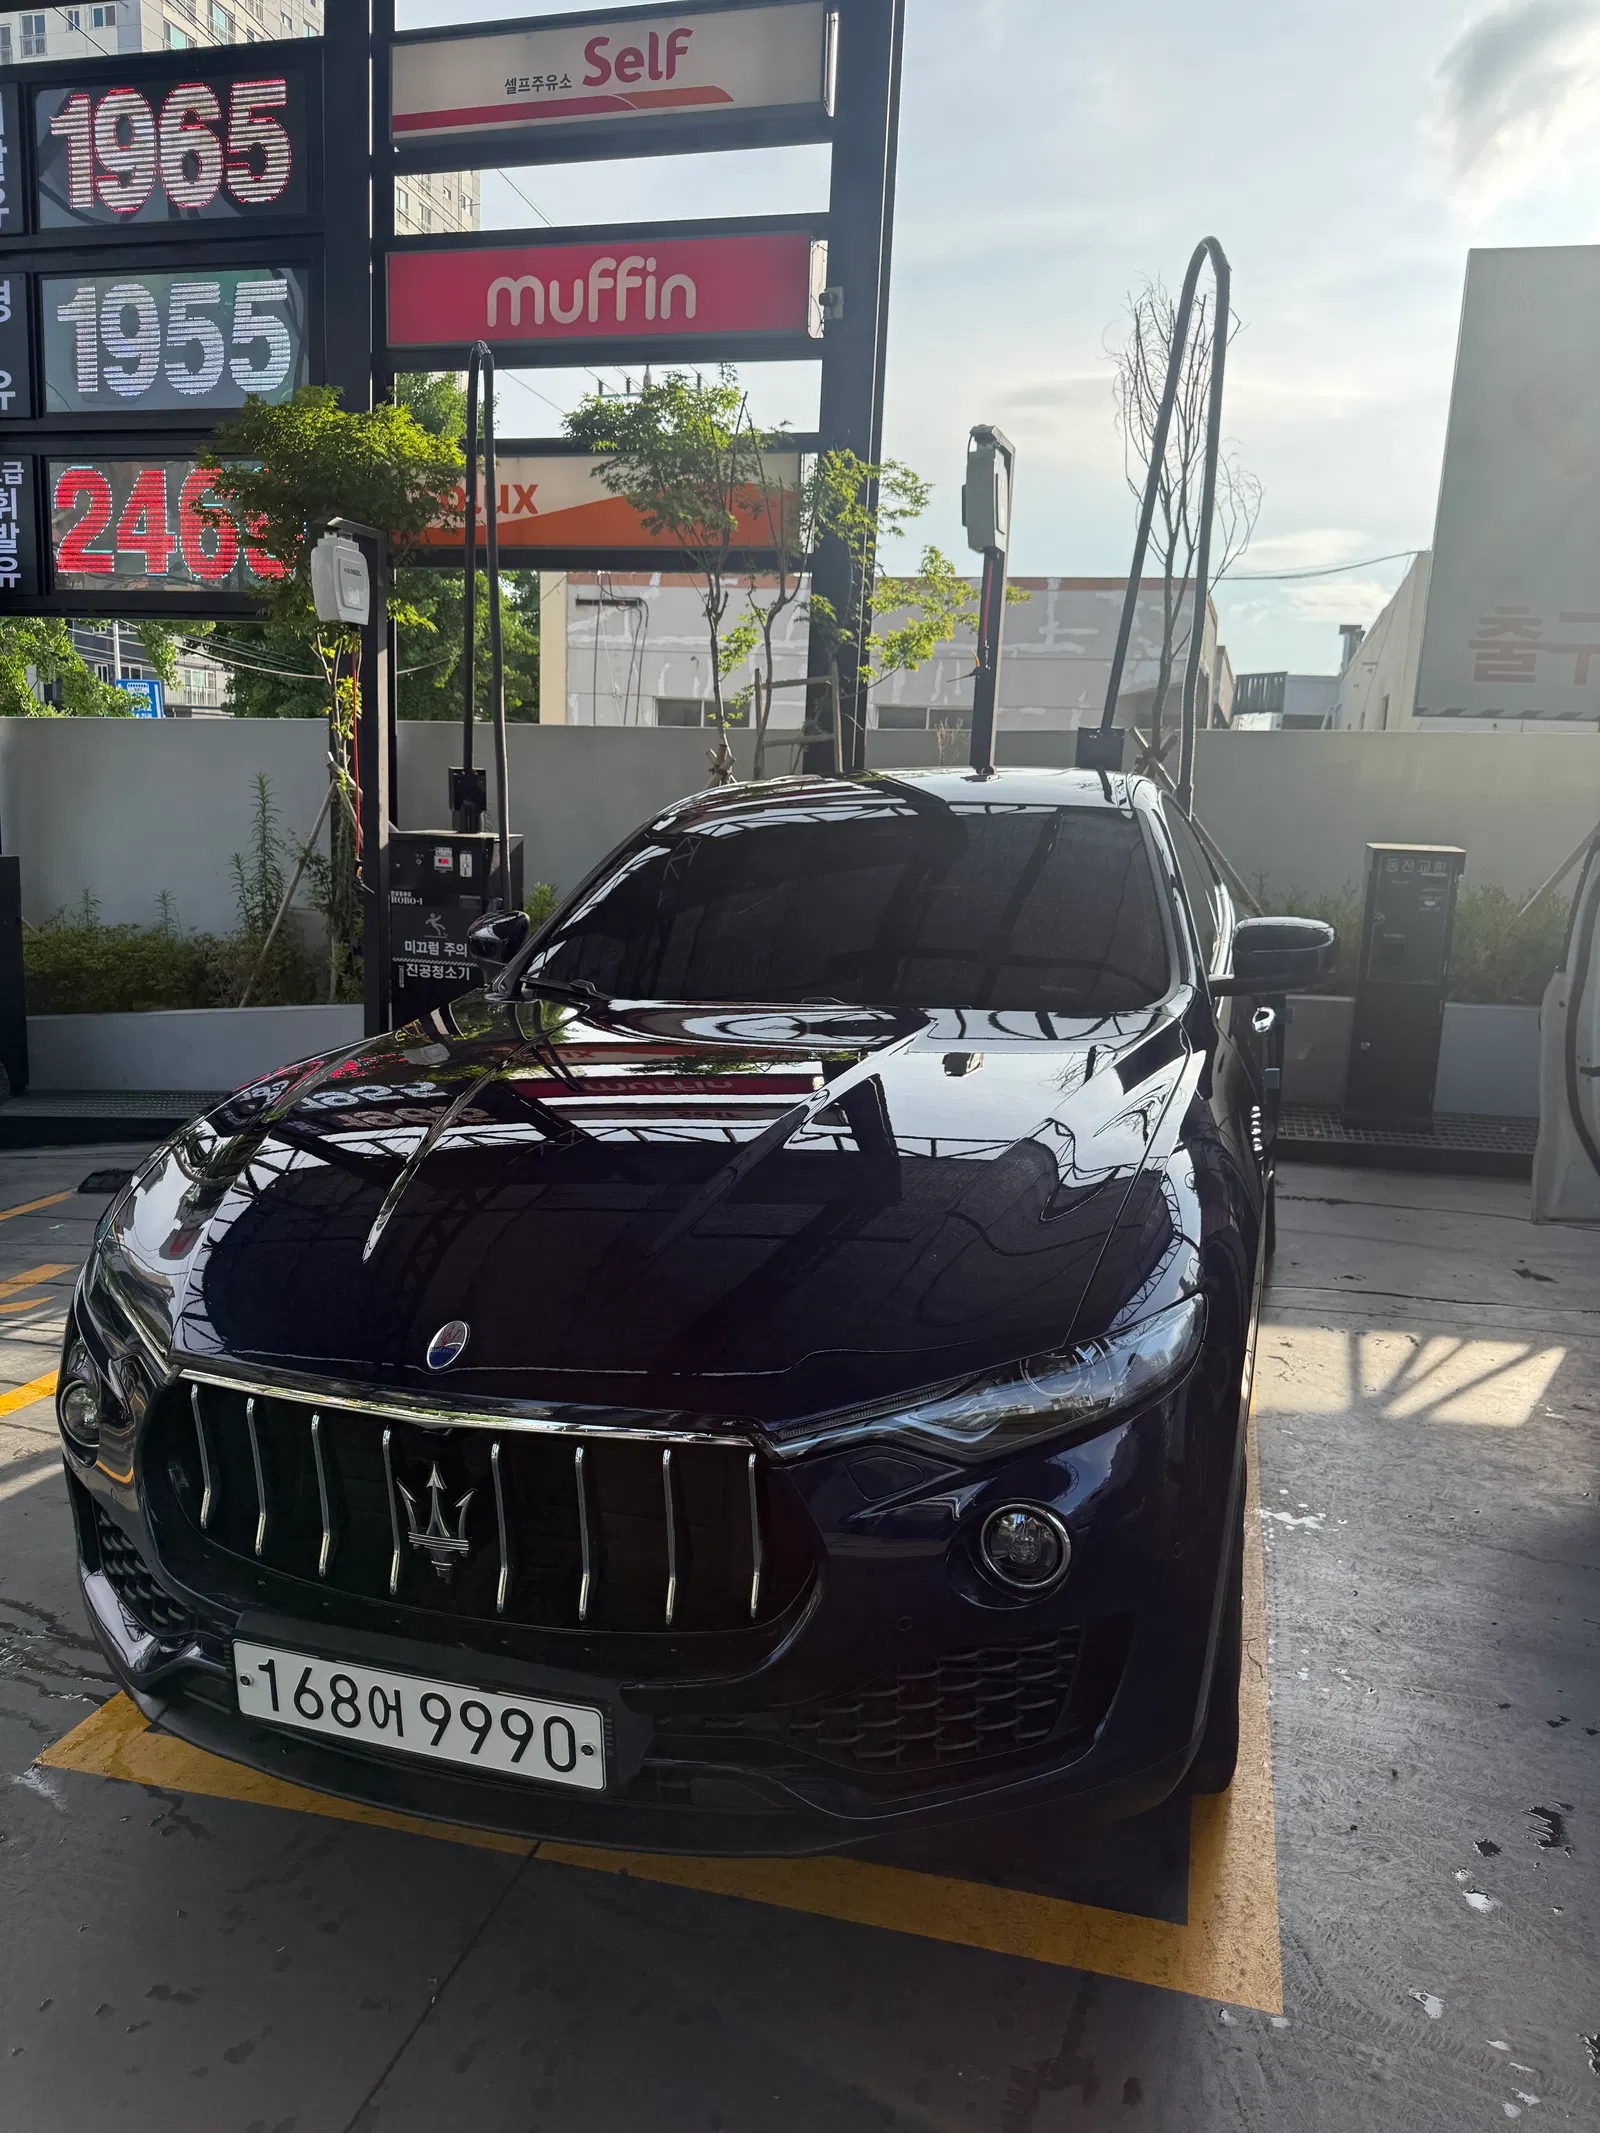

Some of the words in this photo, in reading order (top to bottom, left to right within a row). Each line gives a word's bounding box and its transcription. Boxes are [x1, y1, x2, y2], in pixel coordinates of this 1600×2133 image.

[504, 73, 573, 95] 셀프주유소
[582, 27, 693, 87] Self
[50, 78, 292, 212] 1965
[487, 255, 697, 328] muffin
[57, 279, 291, 397] 1955
[404, 939, 440, 956] 미끄럼
[443, 942, 468, 958] 주의
[405, 963, 471, 981] 진공청소기
[257, 1657, 577, 1773] 168어9990
